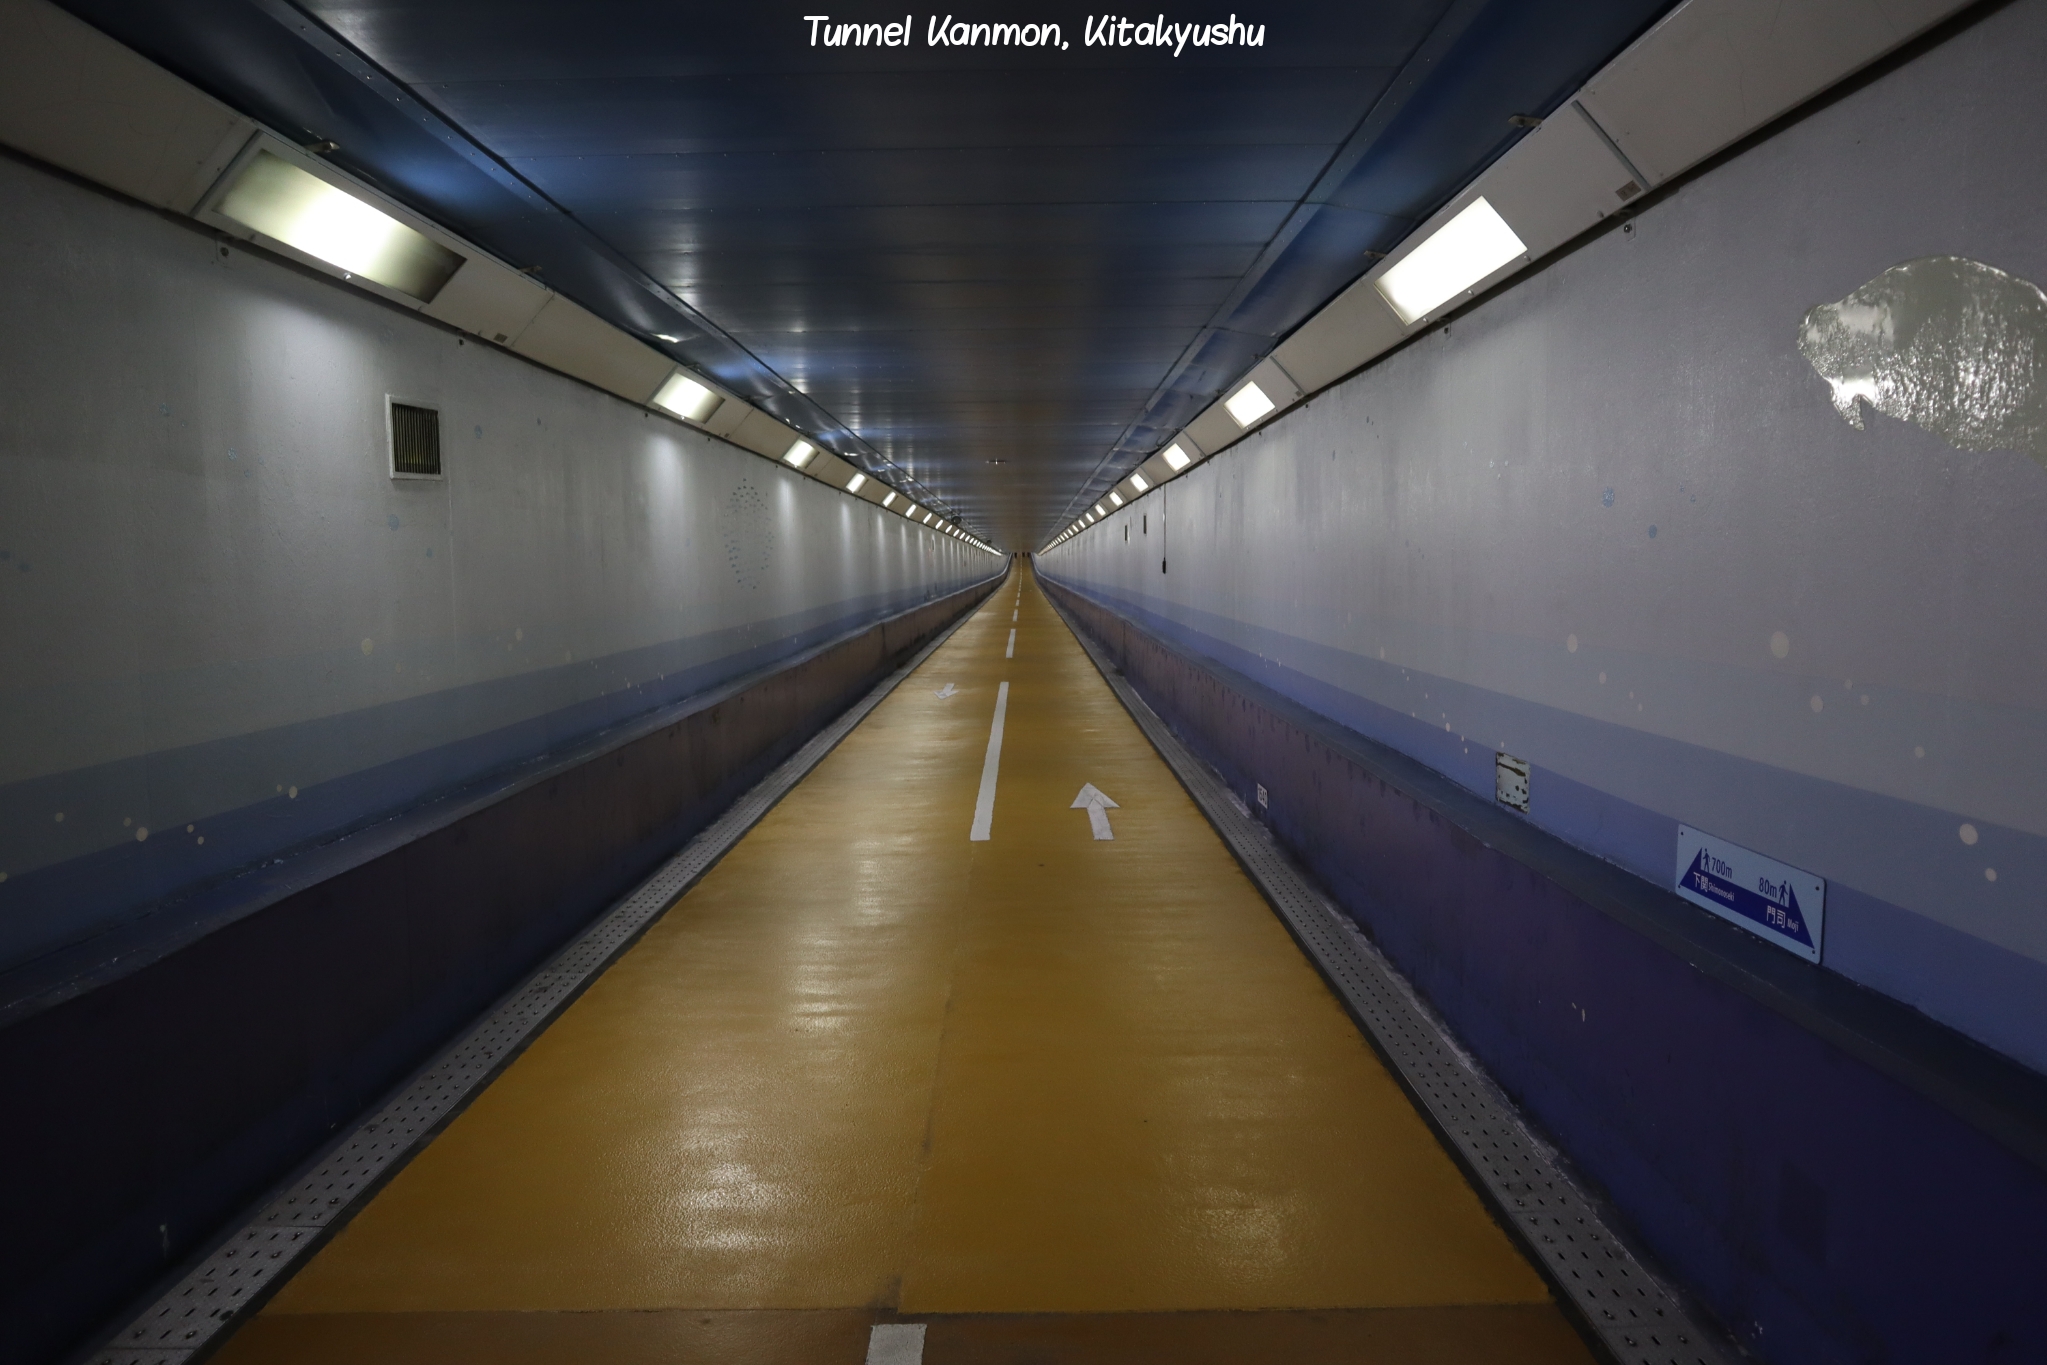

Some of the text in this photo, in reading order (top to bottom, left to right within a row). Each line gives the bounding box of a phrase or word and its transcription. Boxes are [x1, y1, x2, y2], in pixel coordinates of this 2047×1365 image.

[1711, 857, 1733, 879] 700m
[1692, 871, 1735, 902] 下関 Shimonoseki
[1758, 877, 1777, 898] 80m
[1766, 904, 1786, 929] 門司
